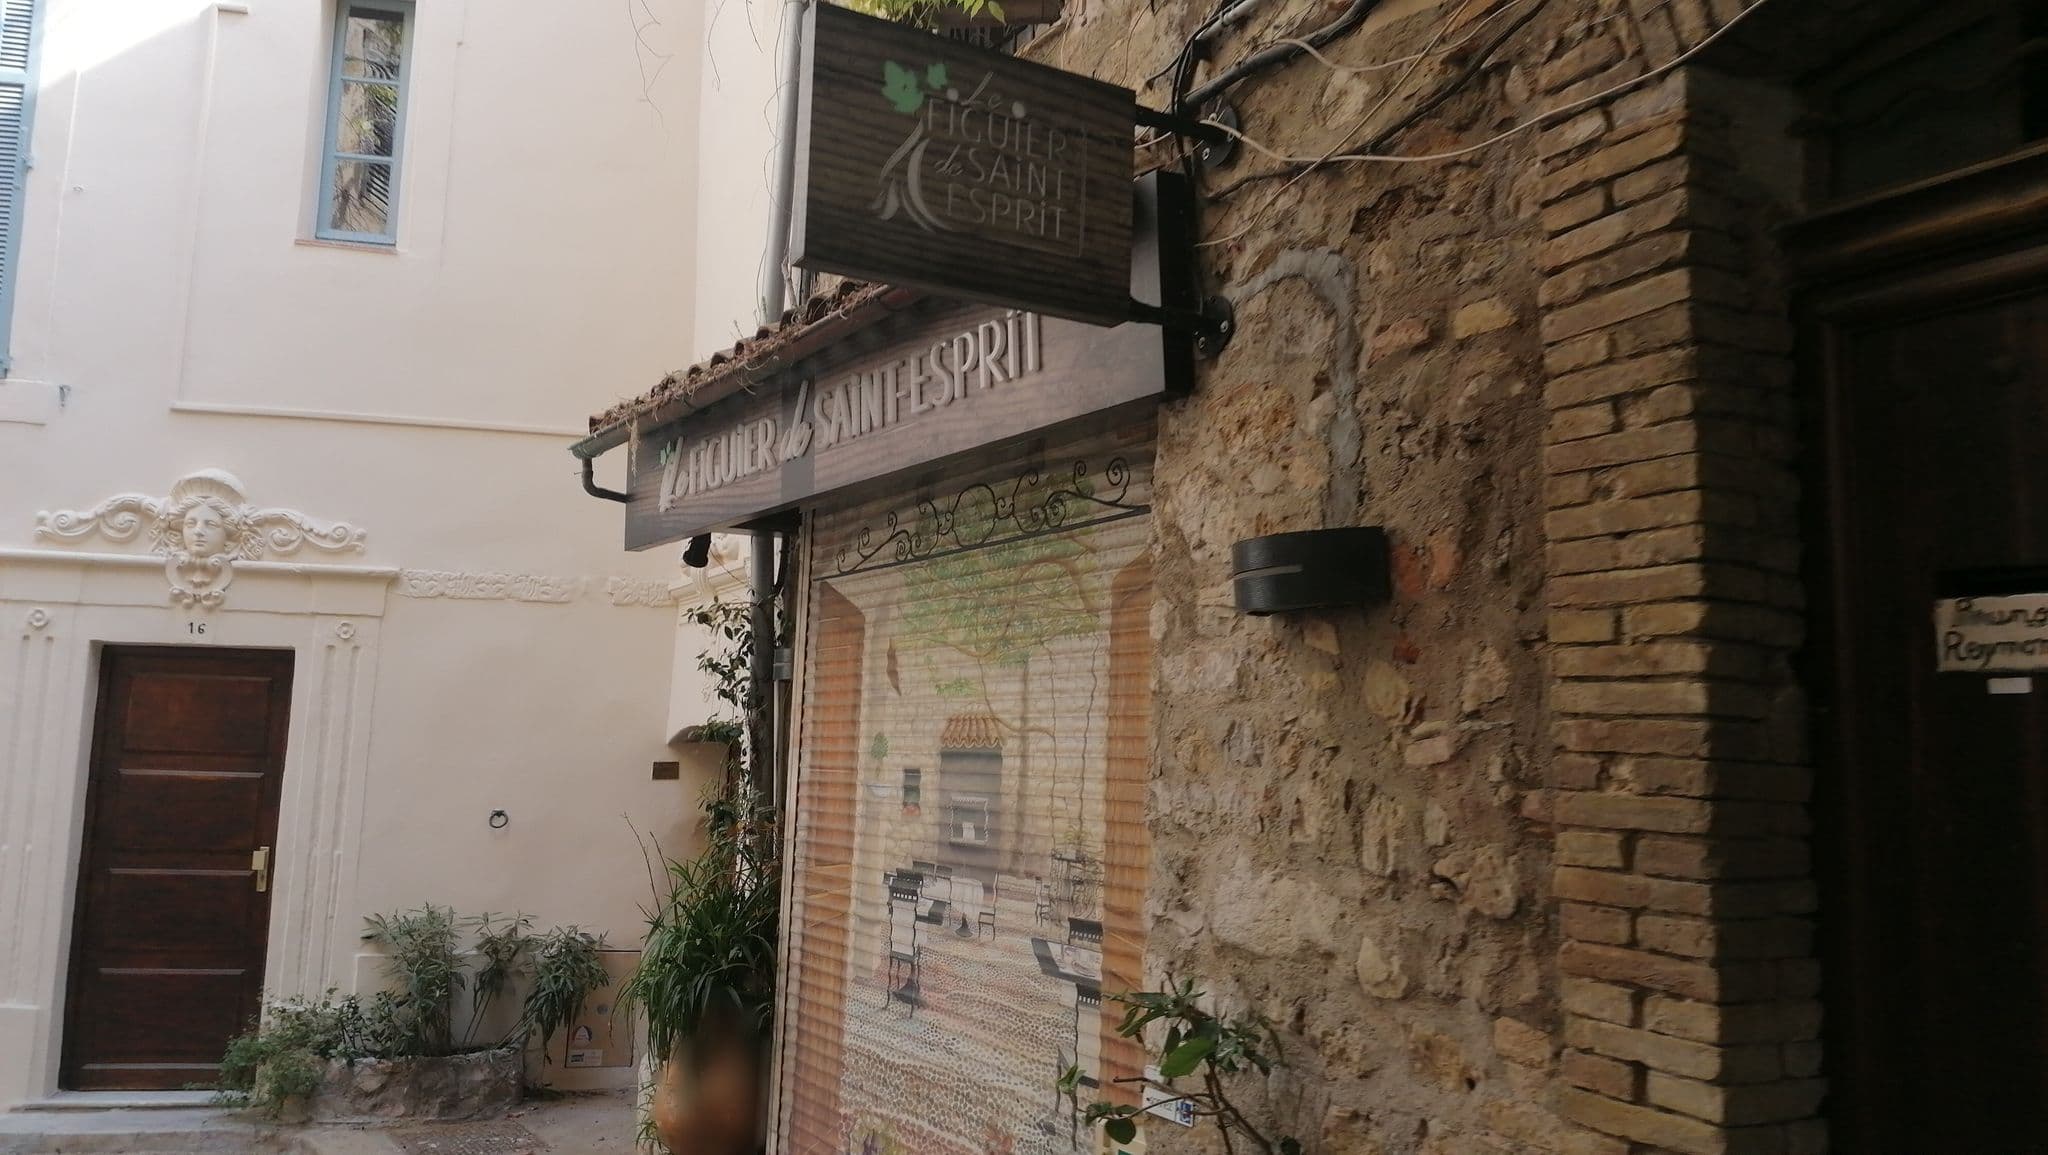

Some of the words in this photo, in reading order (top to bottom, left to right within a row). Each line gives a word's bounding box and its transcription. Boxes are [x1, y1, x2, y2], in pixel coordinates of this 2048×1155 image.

[960, 72, 1002, 111] Le
[934, 144, 966, 177] de
[188, 621, 206, 634] 16
